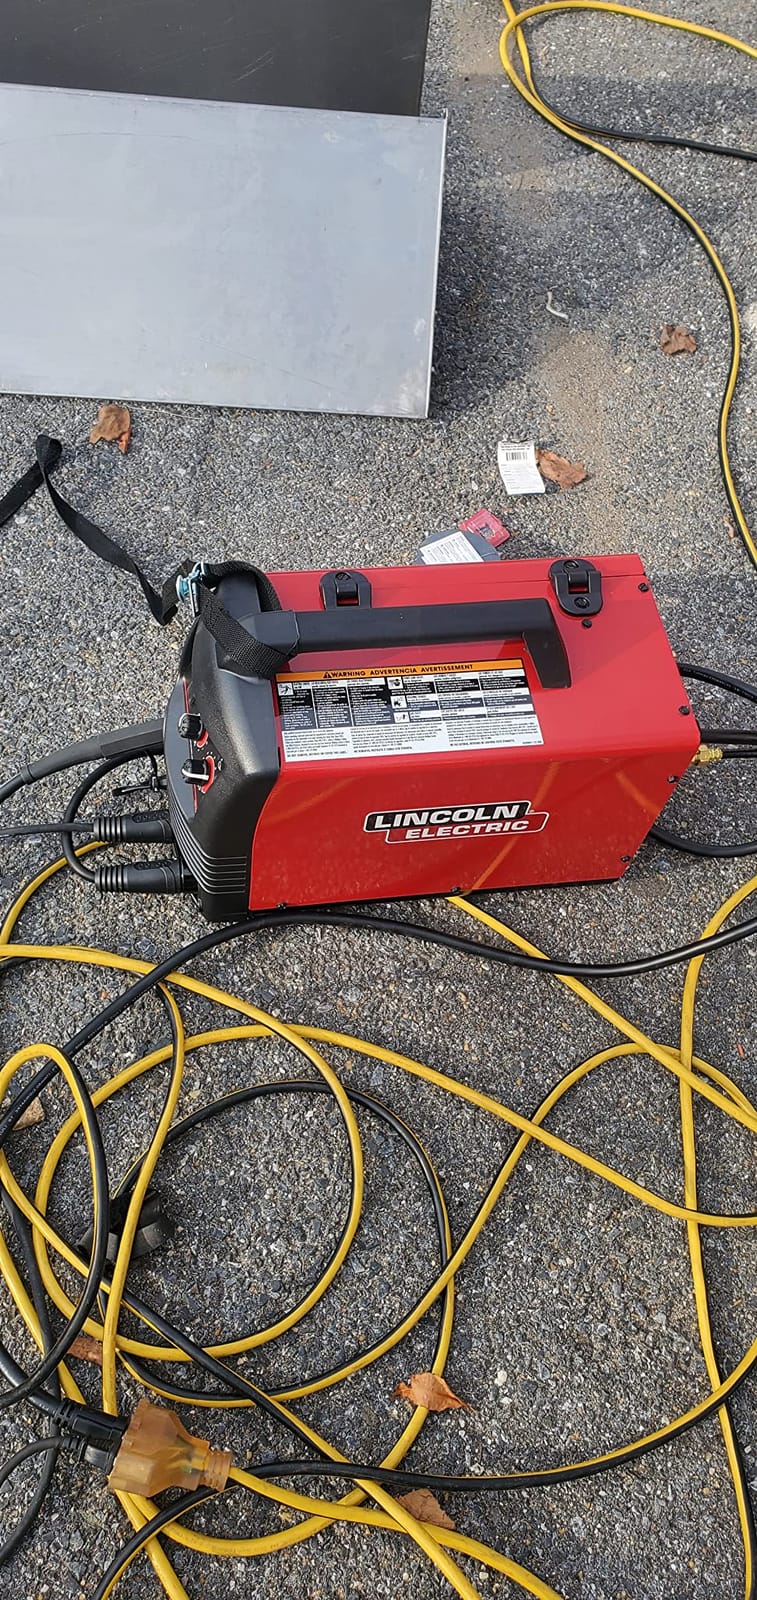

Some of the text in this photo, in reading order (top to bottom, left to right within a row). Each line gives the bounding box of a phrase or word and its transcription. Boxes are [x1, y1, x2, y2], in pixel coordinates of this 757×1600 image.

[331, 664, 473, 678] WARNING ADVERTENCIA AVERTISSEMENT
[374, 804, 520, 829] LINCOLN
[405, 820, 529, 839] ELECTRIC
